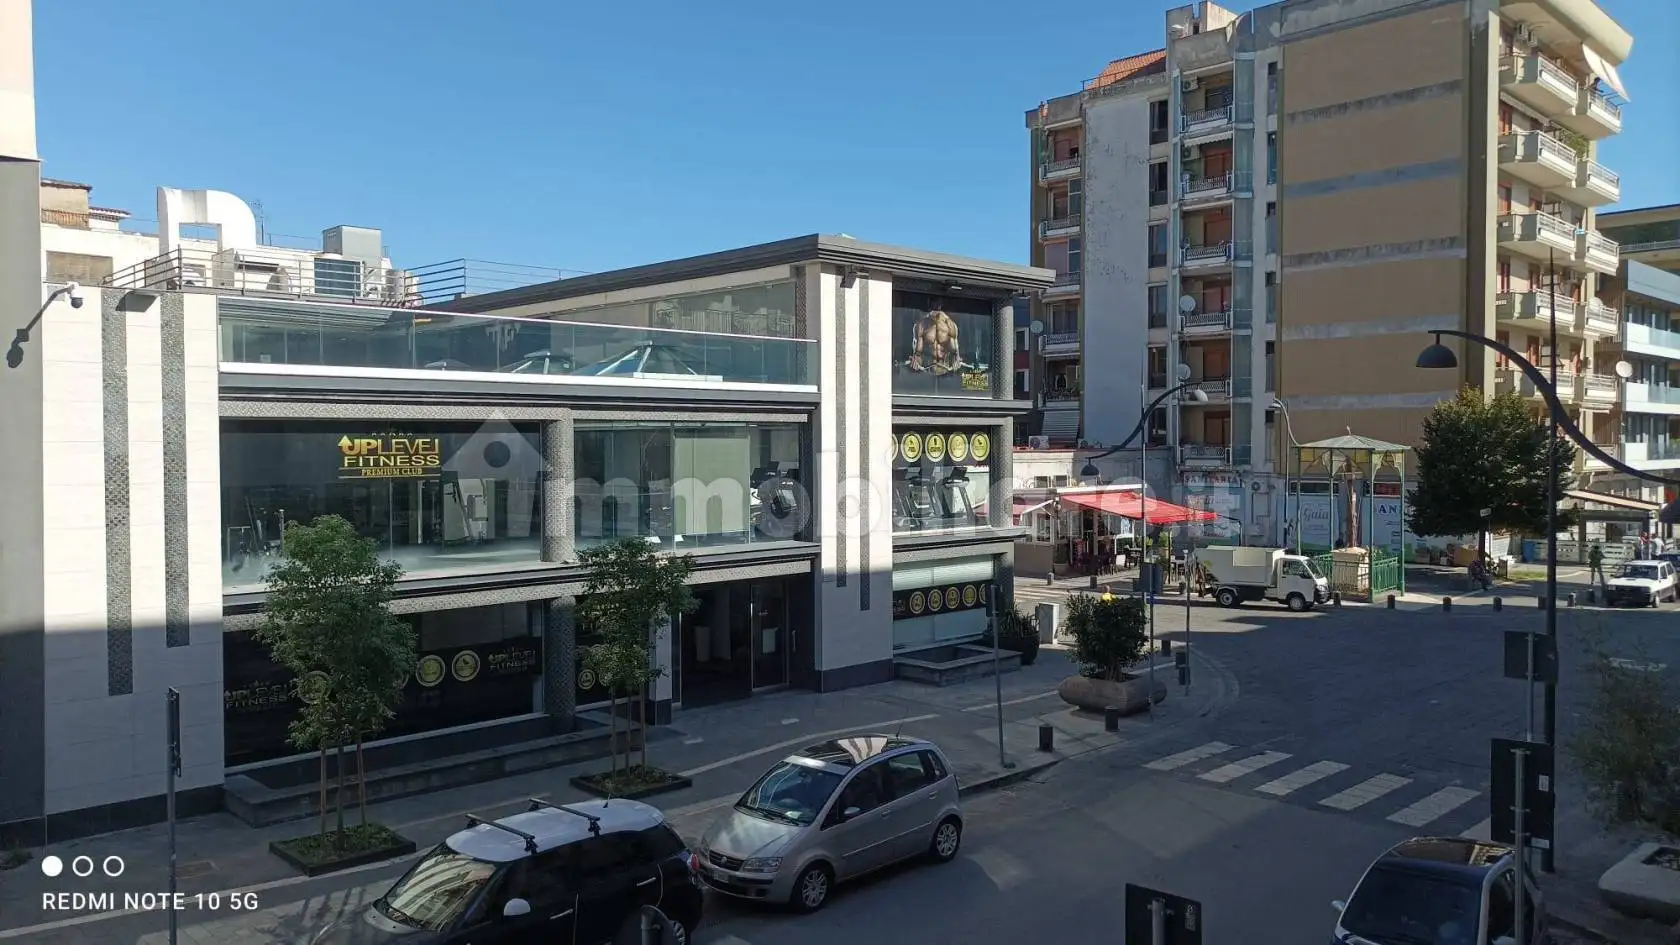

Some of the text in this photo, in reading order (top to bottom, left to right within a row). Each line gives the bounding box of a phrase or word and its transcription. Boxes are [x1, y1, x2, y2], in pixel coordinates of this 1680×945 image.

[344, 455, 440, 467] FITNESS
[361, 467, 423, 477] PREMIUM CLUB
